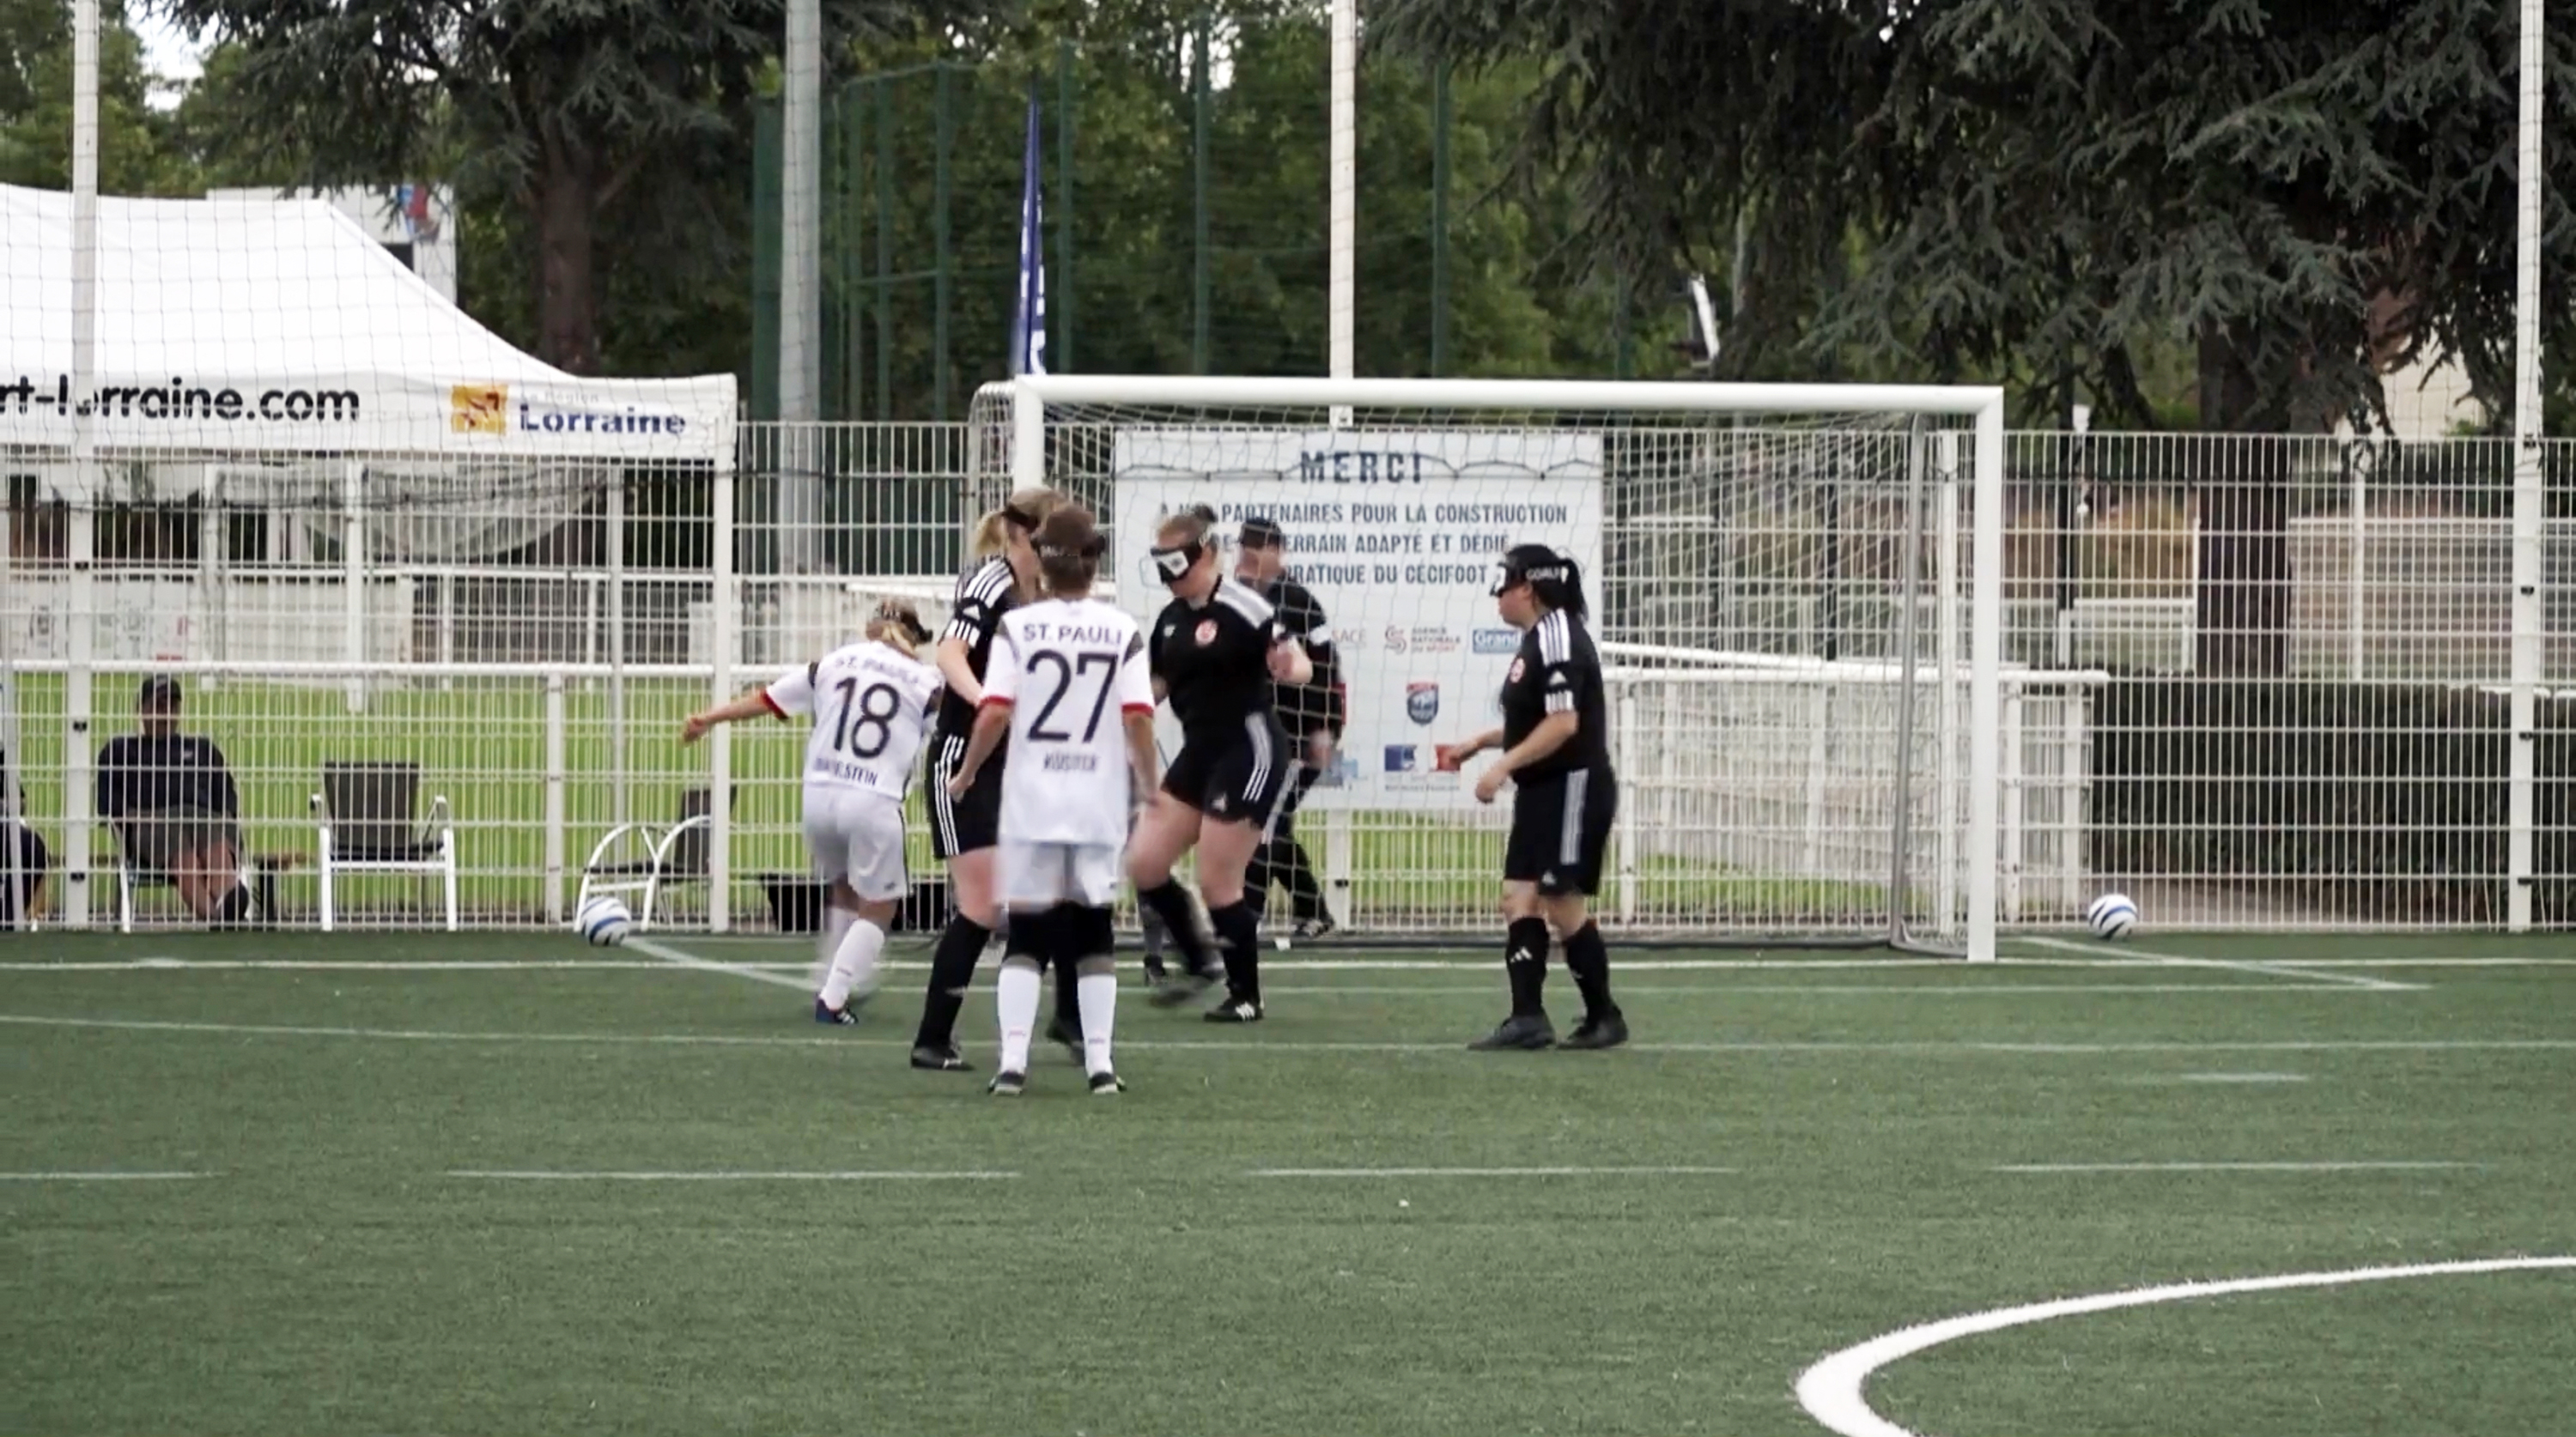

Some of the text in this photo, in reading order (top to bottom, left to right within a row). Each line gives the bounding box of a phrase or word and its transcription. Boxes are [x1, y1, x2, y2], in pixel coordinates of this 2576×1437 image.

[520, 403, 685, 434] Lorraine
[1222, 504, 1342, 522] PARTENAIRES
[1352, 504, 1396, 522] POUR
[1406, 504, 1427, 522] LA
[1435, 504, 1566, 523] CONSTRUCTION
[1285, 534, 1346, 553] ERRAIN
[1355, 529, 1422, 553] ADAPTÉ
[1431, 534, 1452, 553] ET
[1375, 565, 1397, 584] DU
[1406, 559, 1488, 584] CÉCIFOOT
[1024, 624, 1121, 645] ST. PAULI
[1332, 629, 1367, 644] SACE
[1474, 629, 1522, 646] Grand
[1027, 649, 1118, 743] 27
[834, 676, 901, 759] 18
